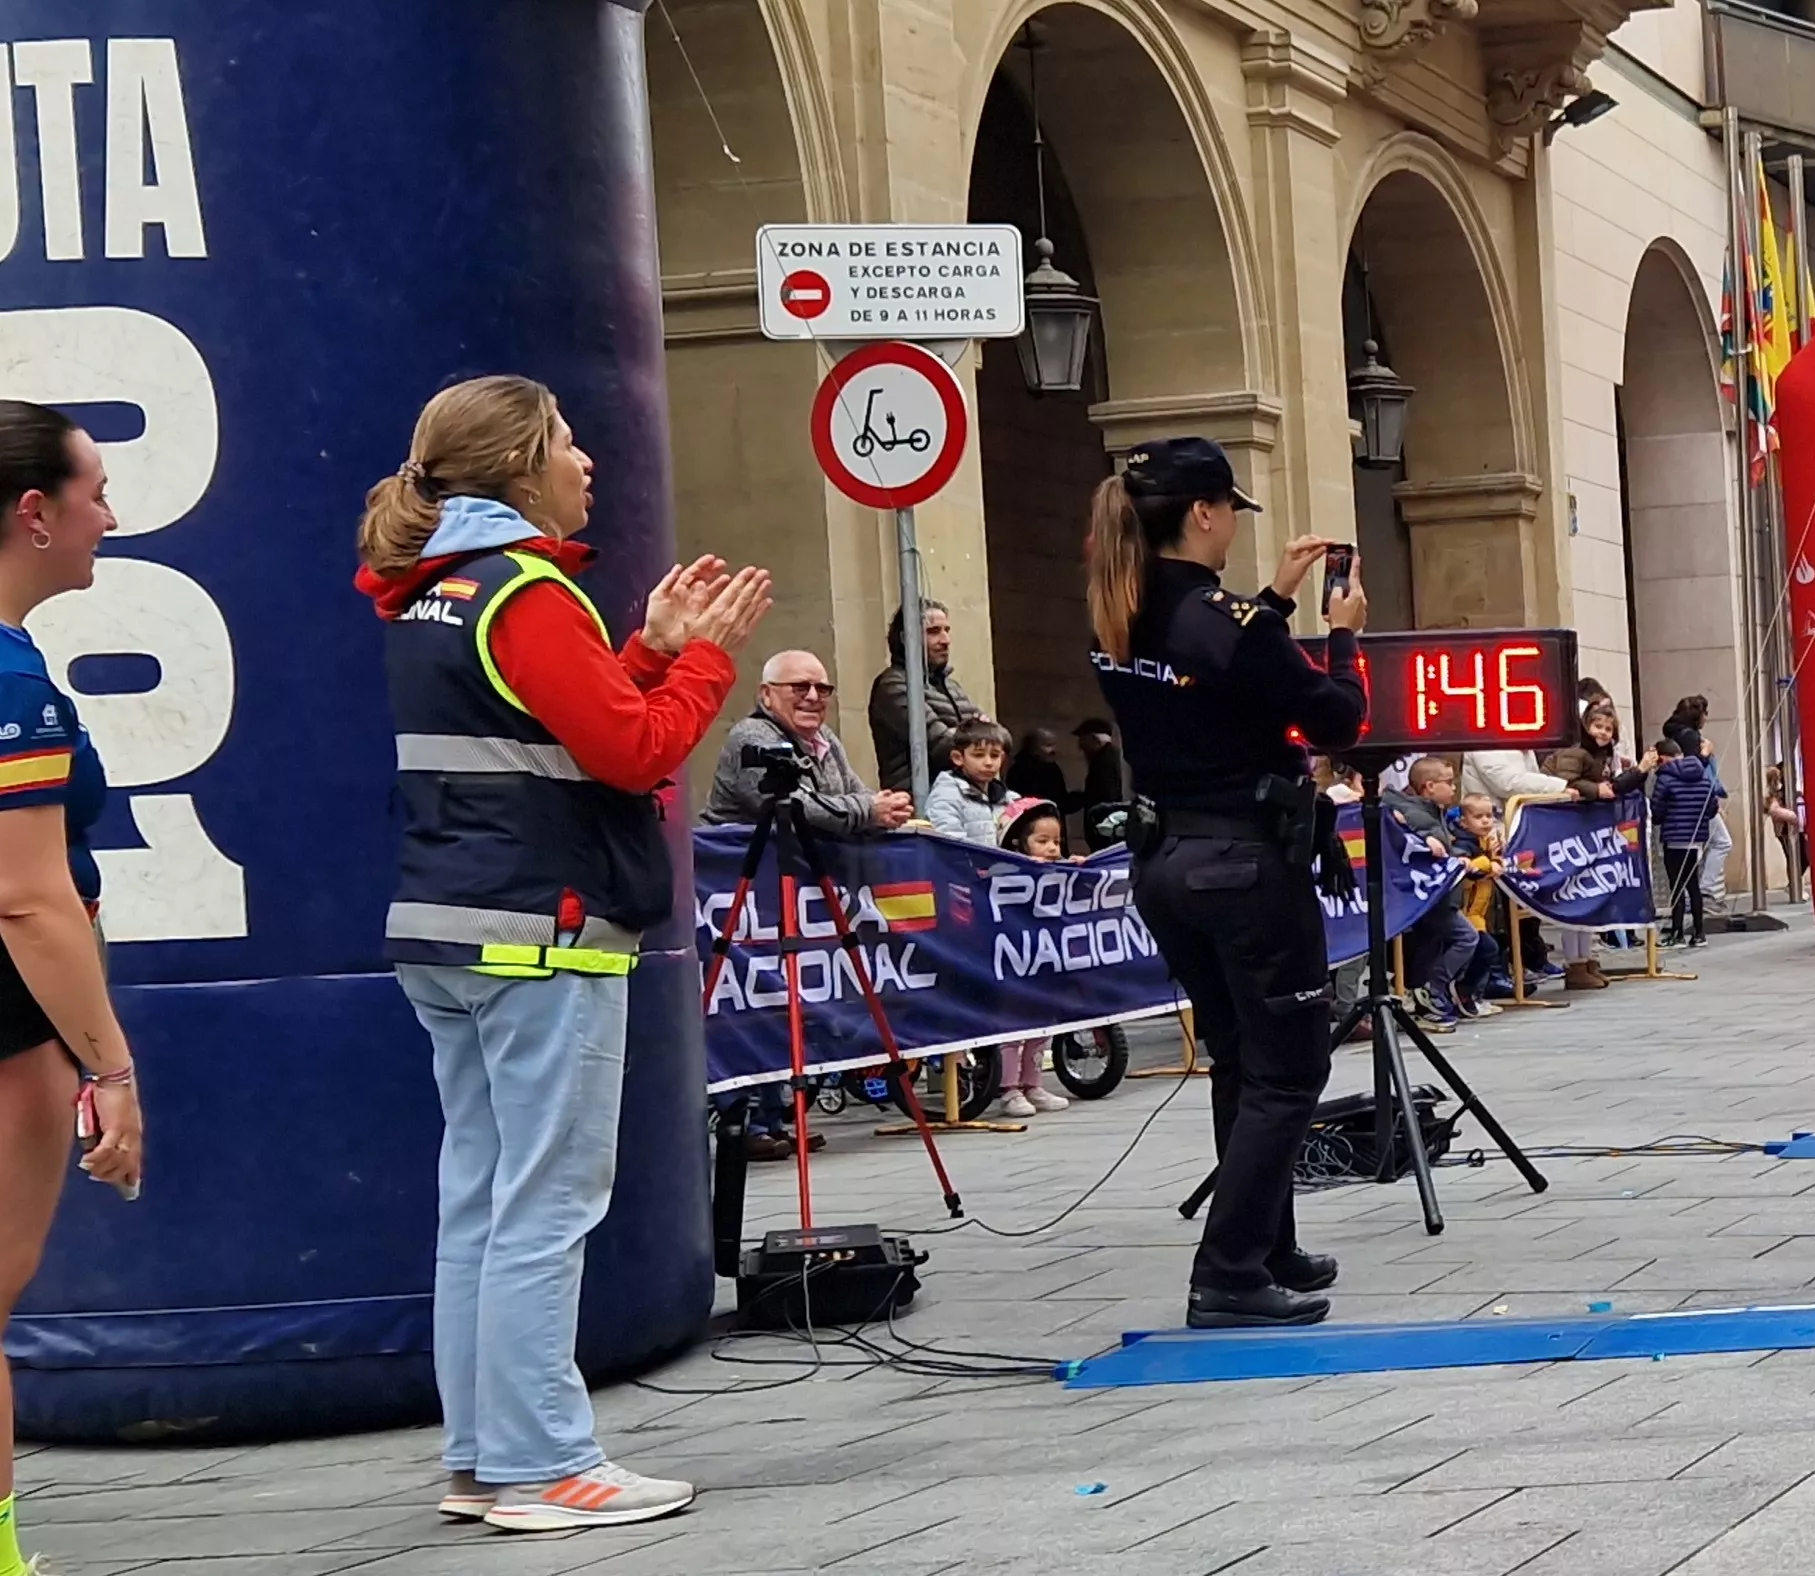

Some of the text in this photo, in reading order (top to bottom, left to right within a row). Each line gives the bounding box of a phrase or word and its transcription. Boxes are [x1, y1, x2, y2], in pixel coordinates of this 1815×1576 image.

[0, 38, 207, 262] TA
[777, 241, 1000, 257] ZONA DE ESTANCIA
[849, 265, 1000, 278] EXCEPTO CARGA
[851, 286, 965, 299] Y DESCARGA
[851, 308, 996, 322] DE 9 A 11 HORAS
[993, 914, 1159, 981] NACION
[699, 943, 938, 1016] ACONAL
